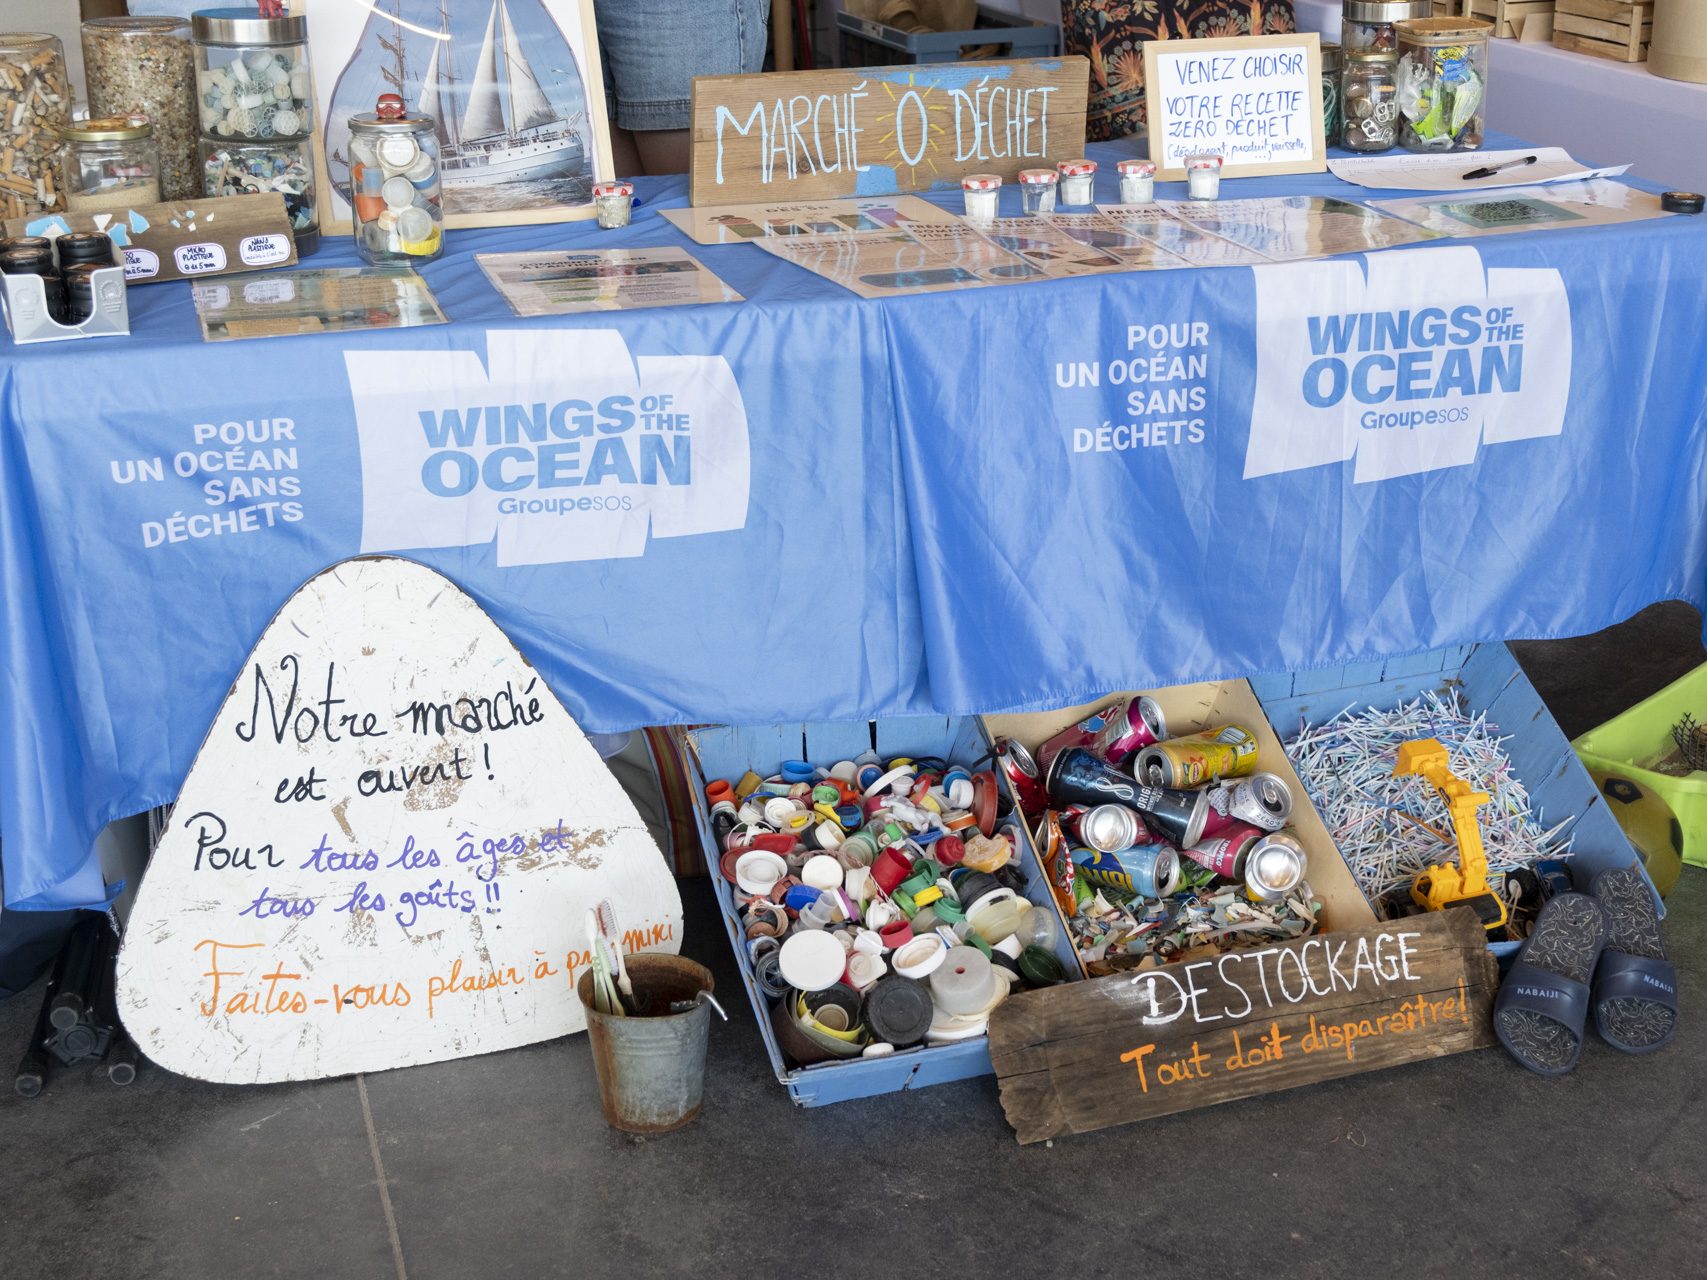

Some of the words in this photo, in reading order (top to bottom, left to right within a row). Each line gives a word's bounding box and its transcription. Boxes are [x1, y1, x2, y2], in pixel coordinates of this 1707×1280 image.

[1176, 57, 1236, 86] VENEZ
[1166, 94, 1223, 119] VOTRE
[1231, 90, 1304, 119] RECETTE
[715, 80, 871, 184] MARCHÉ
[947, 75, 1059, 162] DÉCHET
[1169, 119, 1217, 139] ZERO
[1306, 305, 1482, 356] WINGS
[1485, 323, 1524, 343] THE
[1486, 306, 1514, 325] OF
[1127, 321, 1210, 351] POUR
[1056, 361, 1100, 388] UN
[1108, 351, 1208, 385] OCÉAN
[1302, 343, 1524, 408] OCEAN
[640, 394, 674, 413] OF
[1127, 386, 1206, 416] SANS
[193, 417, 296, 445] POUR
[418, 395, 637, 449] WINGS
[640, 413, 691, 432] THE
[1073, 418, 1206, 453] DÉCHETS
[110, 457, 165, 485] UN
[174, 446, 299, 478] OCÉAN
[421, 433, 692, 498] OCEAN
[204, 476, 302, 507] SANS
[141, 501, 305, 549] DÉCHETS
[235, 654, 388, 745] Notre
[396, 677, 545, 736] marché
[274, 766, 327, 804] est
[357, 747, 472, 797] ouvert
[184, 811, 285, 872] Pour
[300, 832, 379, 872] tous
[386, 835, 441, 869] les
[456, 833, 527, 881] âges
[537, 818, 575, 853] et
[239, 886, 316, 919] tous
[333, 881, 386, 914] les
[395, 879, 477, 927] goûts
[193, 938, 412, 1017] Faites-vous
[428, 957, 525, 1019] plaisir
[533, 950, 558, 982] à
[566, 949, 593, 990] pr
[1131, 931, 1422, 1026] DESTOCKAGE
[1515, 985, 1560, 1000] NABAIJI
[1642, 973, 1675, 995] NABAIJI
[1120, 1040, 1212, 1094] Tout
[1225, 1021, 1292, 1073] doit
